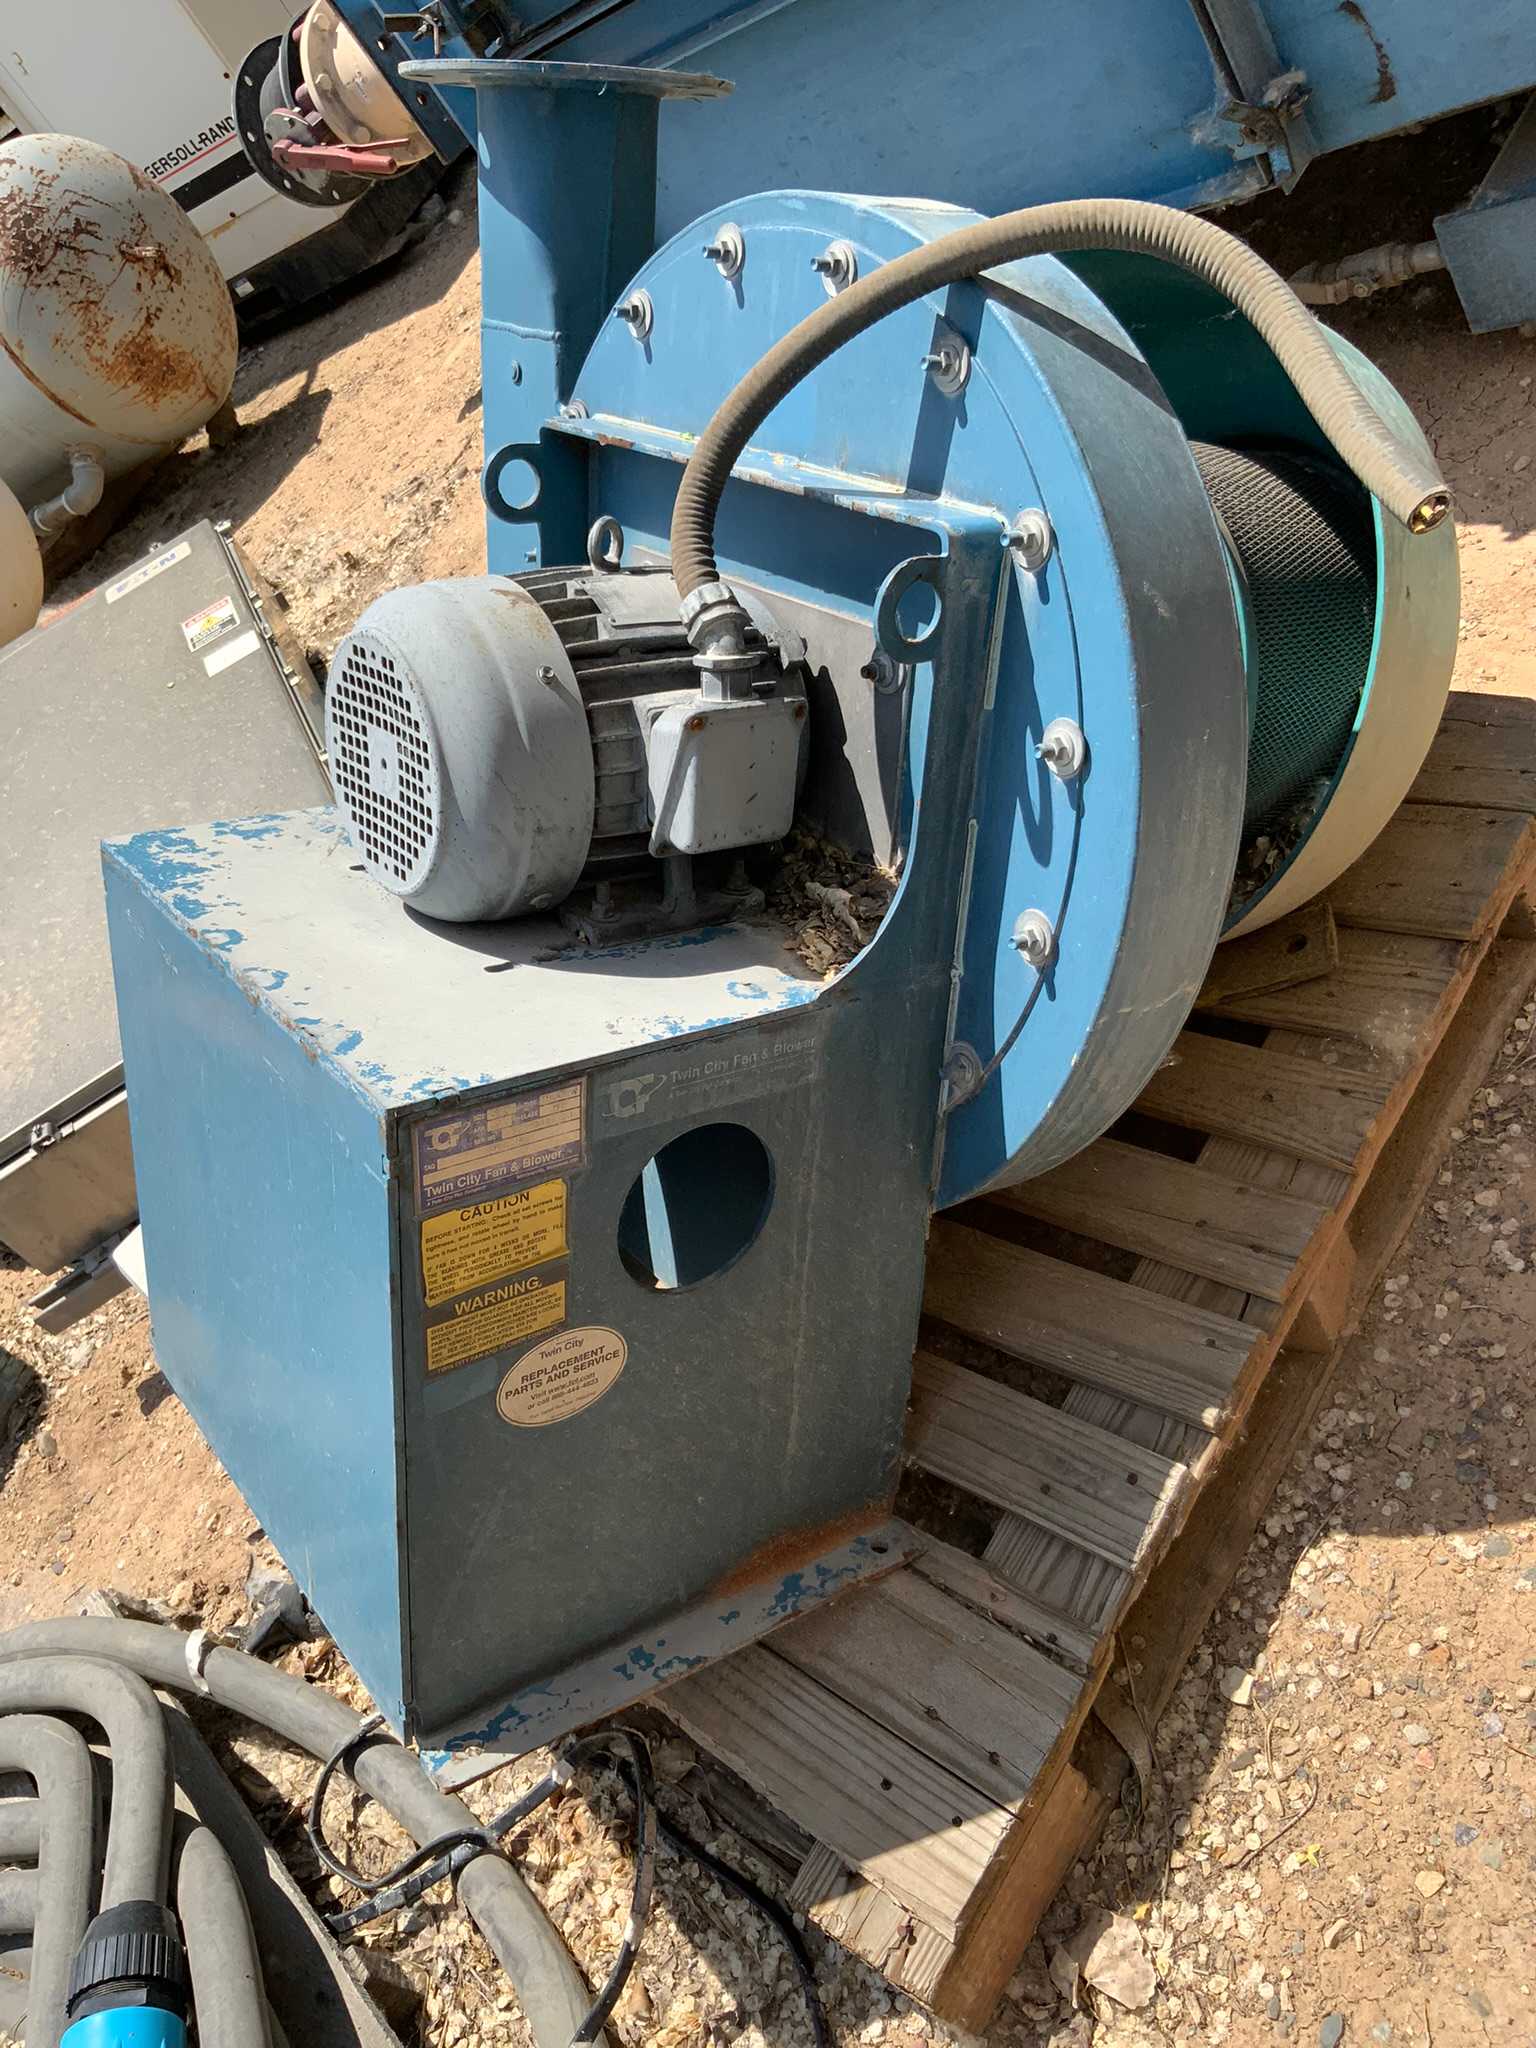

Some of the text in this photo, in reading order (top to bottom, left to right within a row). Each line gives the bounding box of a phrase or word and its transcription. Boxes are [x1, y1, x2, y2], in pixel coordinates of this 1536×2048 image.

[670, 1066, 699, 1083] Twin
[424, 1182, 454, 1197] Twin
[457, 1173, 481, 1189] City
[485, 1165, 508, 1180] Fan
[510, 1161, 520, 1173] &
[523, 1150, 563, 1168] Blower
[460, 1191, 530, 1221] CAUTION
[426, 1230, 452, 1244] BEFORE
[454, 1276, 539, 1316] WARNING
[538, 1347, 562, 1360] Twin
[564, 1337, 584, 1351] City
[504, 1379, 542, 1400] PARTS
[546, 1369, 570, 1384] AND
[573, 1349, 620, 1374] SERVICE
[521, 1345, 606, 1385] REPLACEMENT
[527, 1402, 534, 1410] or
[537, 1396, 550, 1406] call
[530, 1388, 547, 1400] Visit
